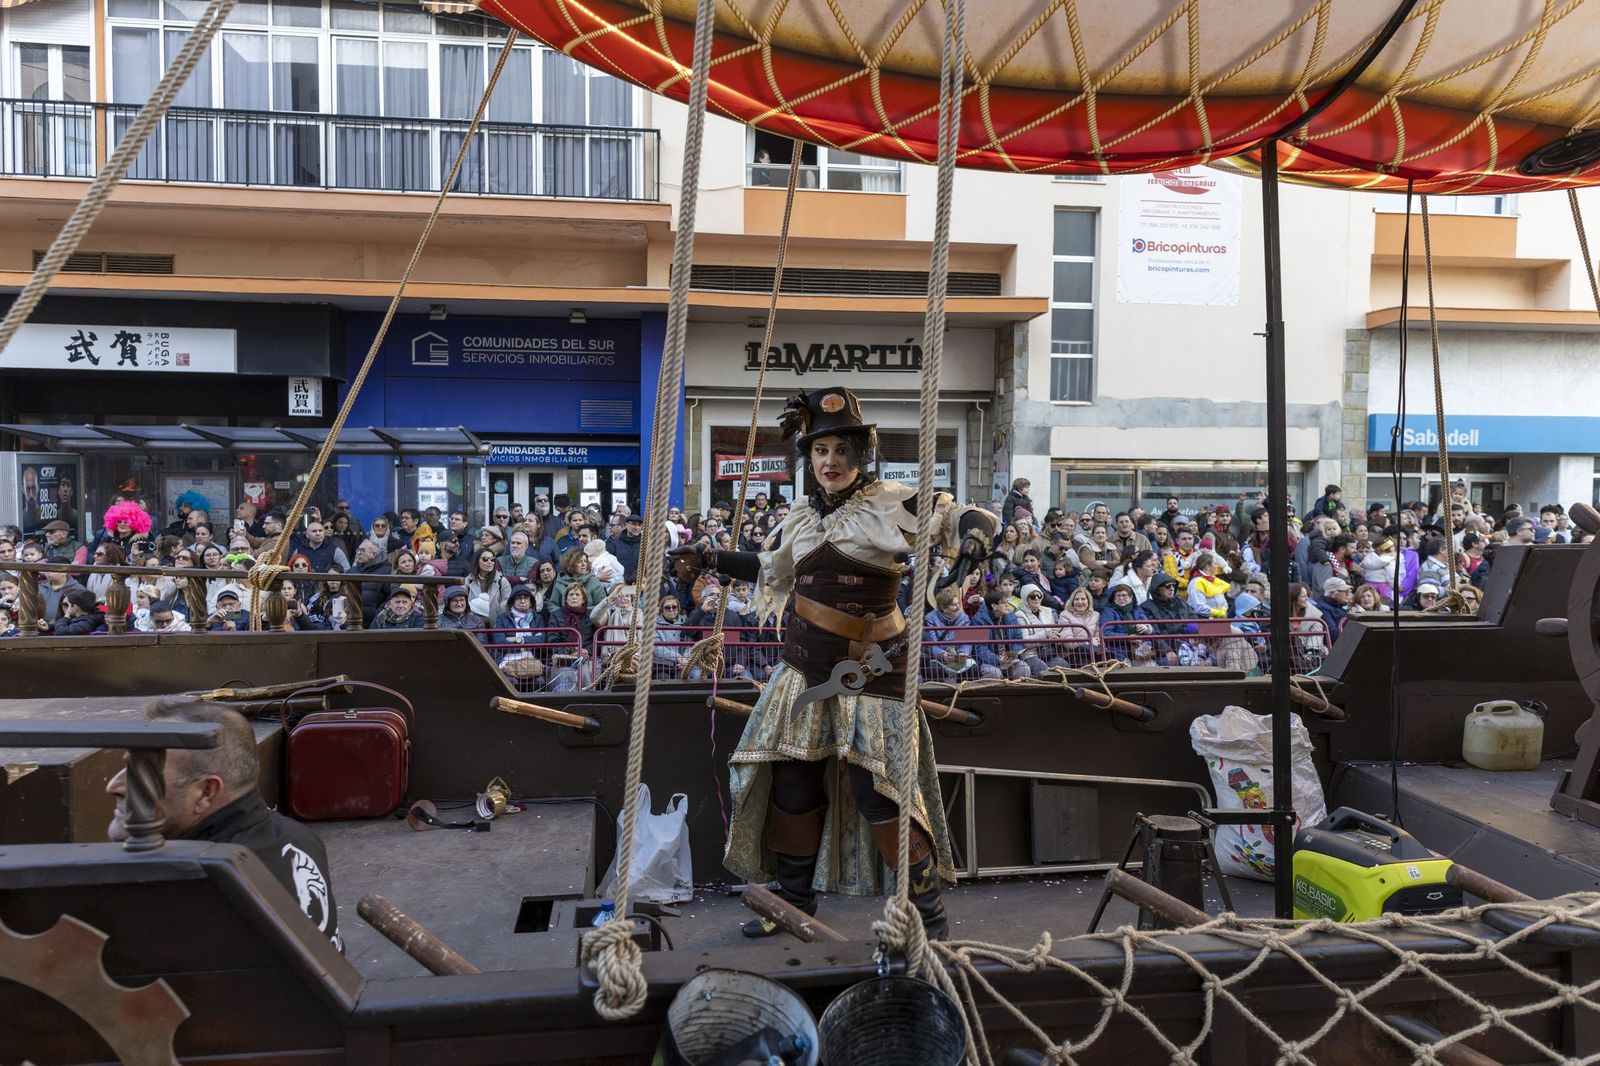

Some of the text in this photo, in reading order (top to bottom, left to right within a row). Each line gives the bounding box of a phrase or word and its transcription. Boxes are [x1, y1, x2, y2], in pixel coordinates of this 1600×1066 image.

[1147, 241, 1227, 254] Bricopinturas
[64, 329, 142, 367] 武賀
[160, 332, 170, 366] BUGA
[462, 336, 615, 351] COMUNIDADES DEL SUR
[462, 352, 615, 366] SERVICIOS INMOBILIARIOS
[491, 446, 588, 456] MUNIDADES DEL SUR
[486, 455, 588, 464] RVICIOS INMOBILIARIOS
[722, 461, 760, 474] ¡ÚLTIOS
[884, 471, 905, 479] RESTOS
[40, 503, 58, 519] 2026
